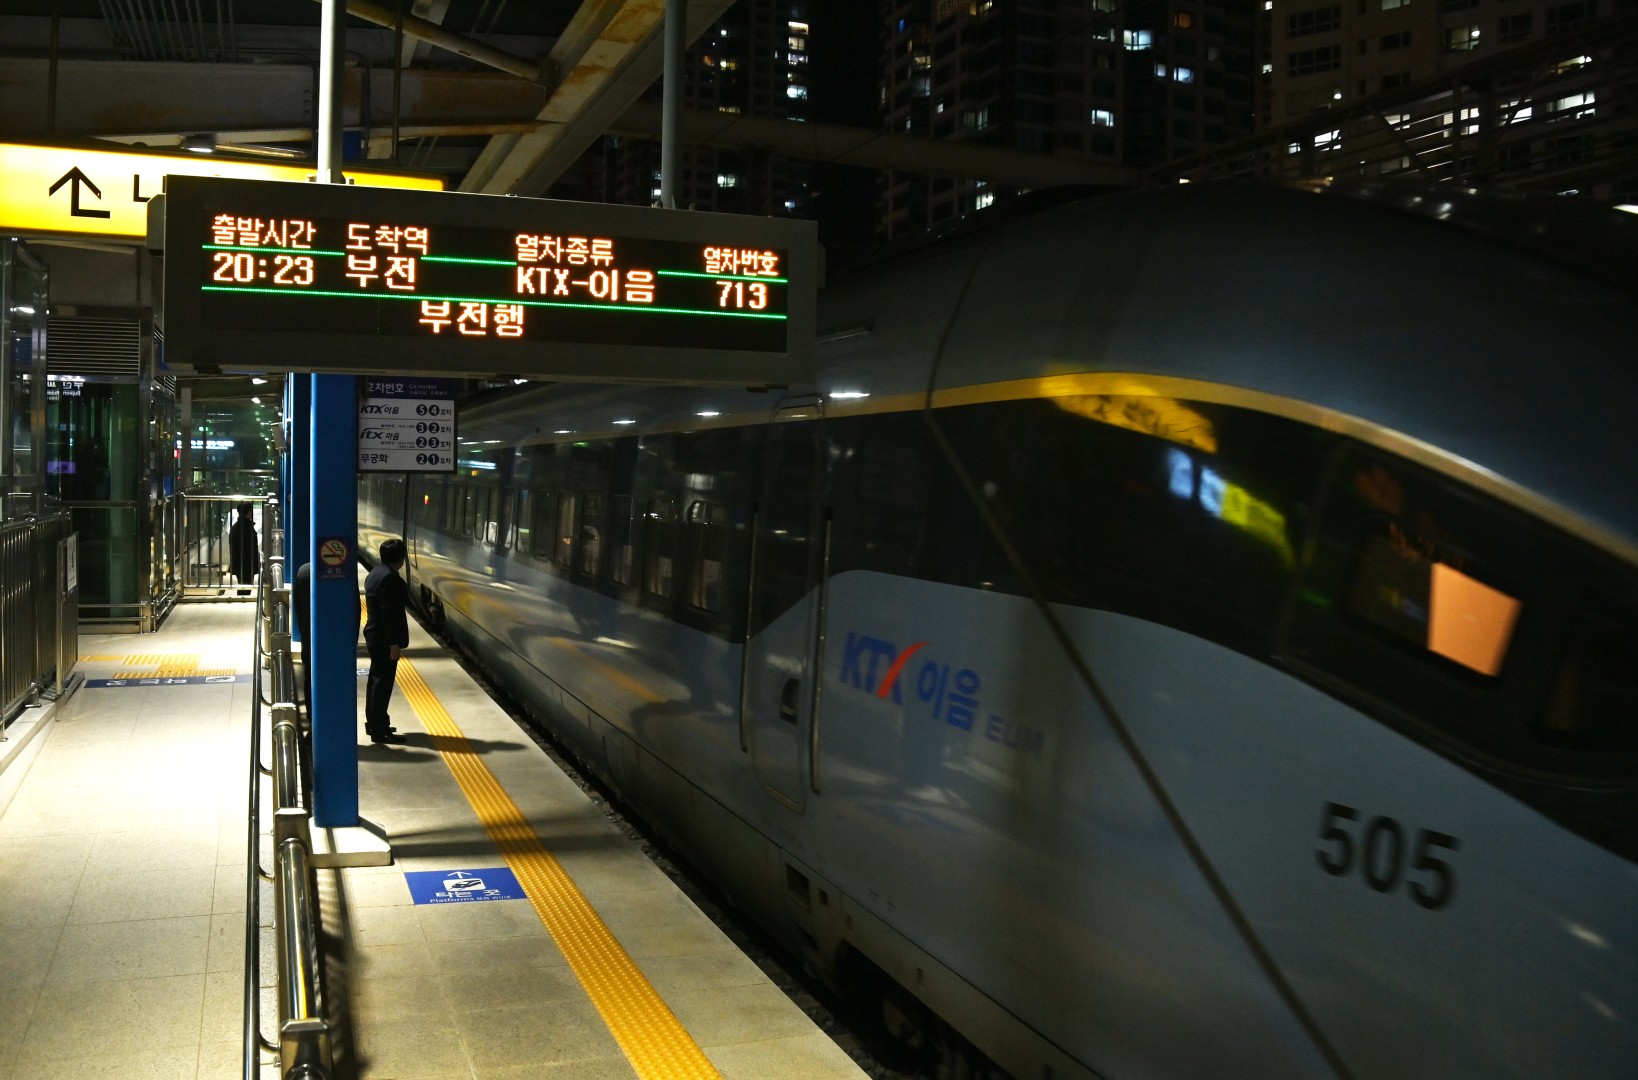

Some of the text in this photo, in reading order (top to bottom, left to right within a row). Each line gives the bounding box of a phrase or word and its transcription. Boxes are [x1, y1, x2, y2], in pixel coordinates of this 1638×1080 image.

[212, 213, 779, 277] 출발시간 도착역 열차종류 열차번호
[213, 252, 767, 309] 20:23 부전 KTX-이음 713
[419, 300, 524, 337] 부전행
[360, 404, 387, 414] KTX
[361, 453, 388, 464] 무궁화
[839, 631, 930, 706] KTX
[916, 660, 981, 732] 이음
[1314, 801, 1463, 911] 505
